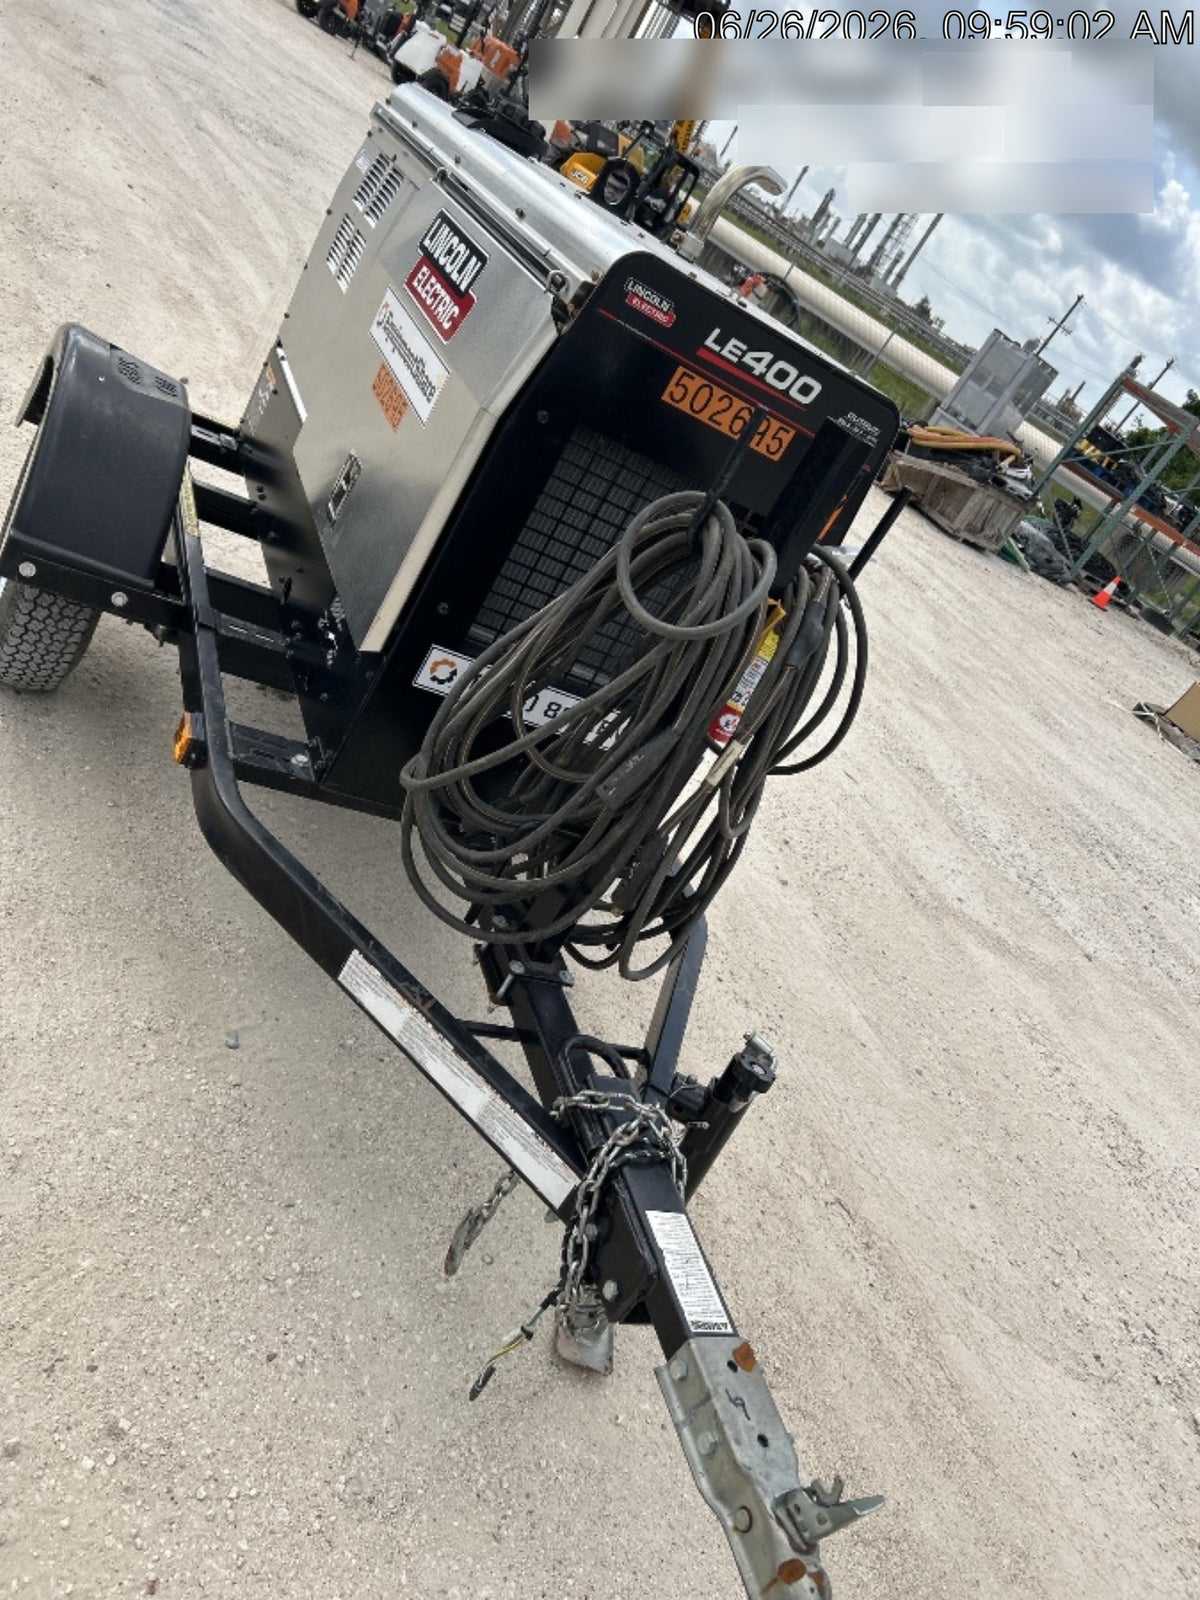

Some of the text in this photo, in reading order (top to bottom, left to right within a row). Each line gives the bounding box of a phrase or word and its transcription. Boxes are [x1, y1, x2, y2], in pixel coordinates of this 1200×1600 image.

[423, 218, 482, 293] LINCOLN
[412, 265, 460, 330] ELECTRIC
[627, 279, 671, 313] LINCOLN
[704, 327, 822, 404] LE400
